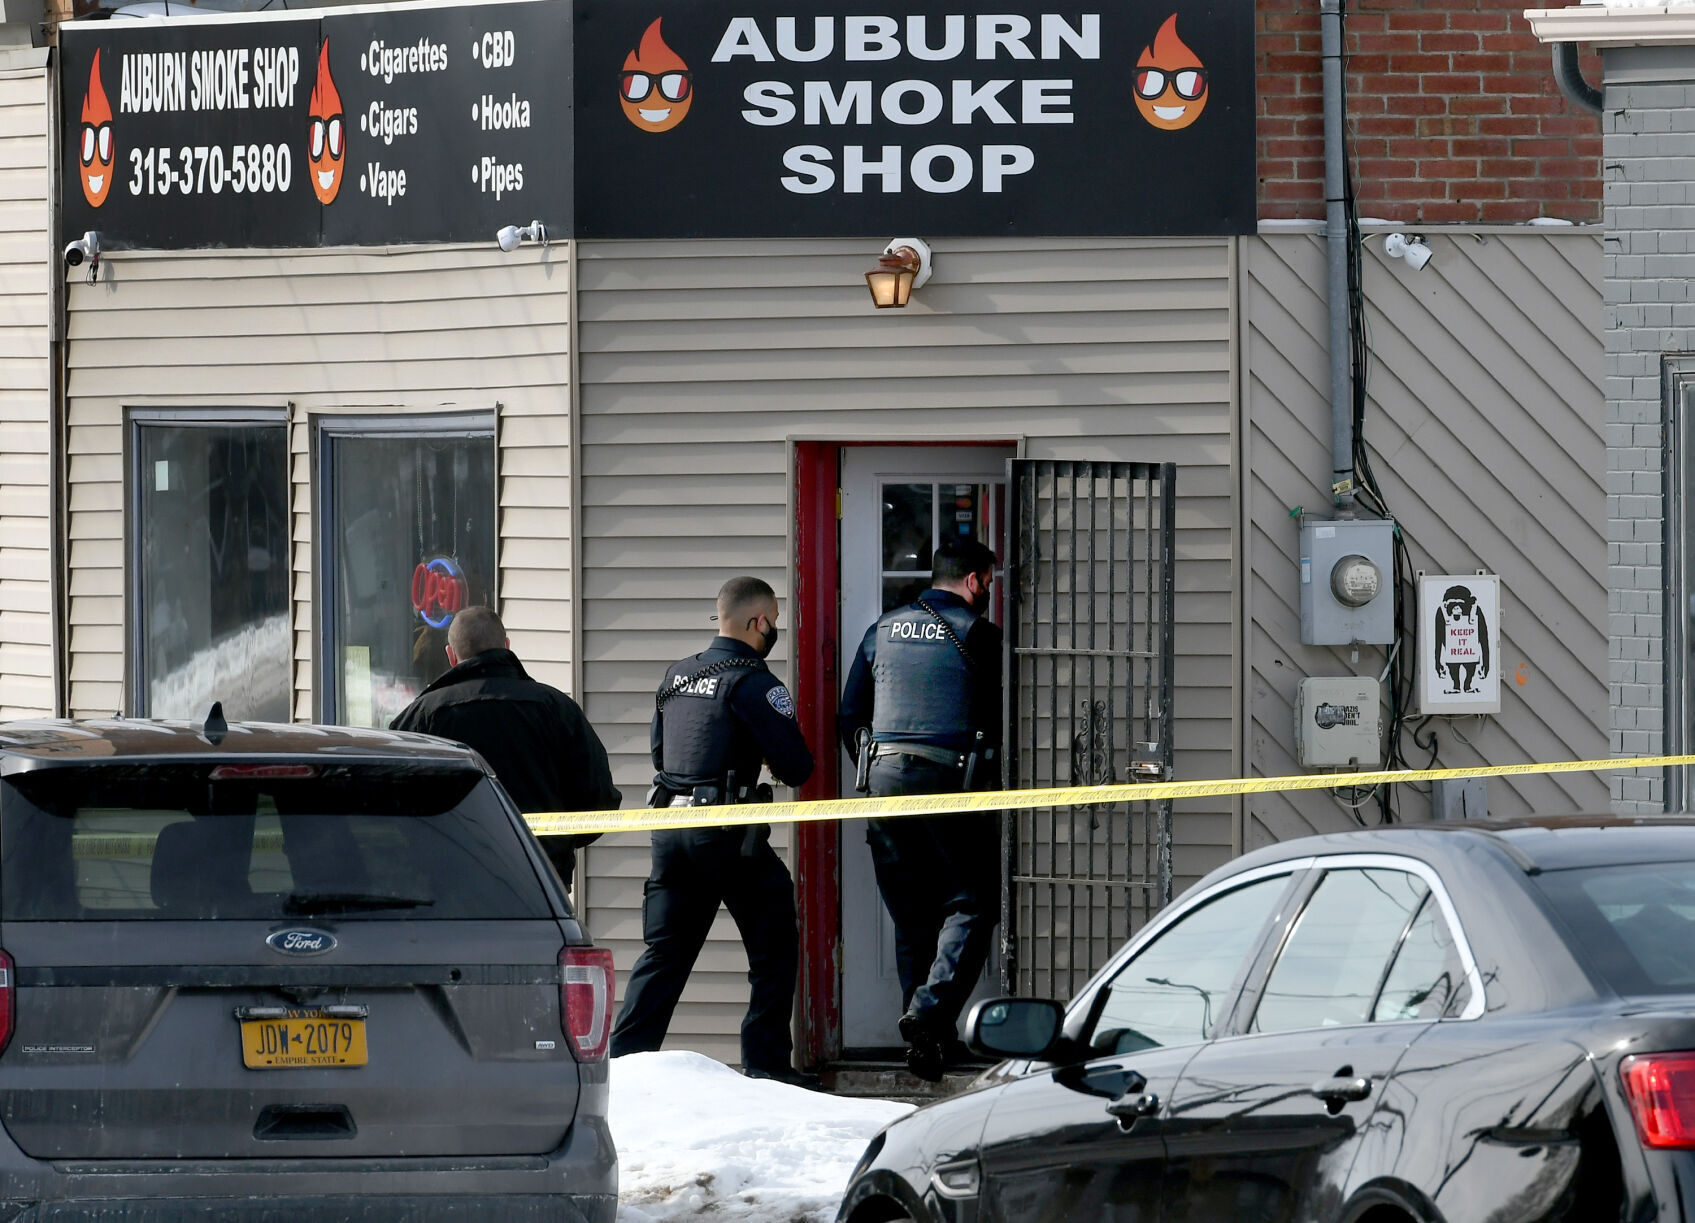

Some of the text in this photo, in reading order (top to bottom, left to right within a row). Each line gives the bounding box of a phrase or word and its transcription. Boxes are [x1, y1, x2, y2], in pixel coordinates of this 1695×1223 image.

[481, 30, 515, 69] CBD
[711, 14, 1100, 63] AUBURN
[120, 46, 299, 113] AUBURN SMOKE SHOP
[368, 37, 448, 84] Cigarettes
[481, 92, 531, 131] Hooka
[741, 79, 1074, 126] SMOKE
[368, 100, 418, 145] Cigars
[128, 142, 292, 196] 315-370-5880
[367, 161, 407, 206] Vape
[481, 156, 524, 201] Pipes
[780, 144, 1036, 194] SHOP
[890, 621, 946, 640] POLICE
[1450, 628, 1475, 637] KEEP
[1458, 638, 1468, 646] IT
[1450, 647, 1476, 656] REAL
[672, 674, 718, 696] POLICE
[284, 932, 323, 950] Ford
[256, 1022, 353, 1055] JDW 2079
[275, 1055, 337, 1065] EMPIRE STATE
